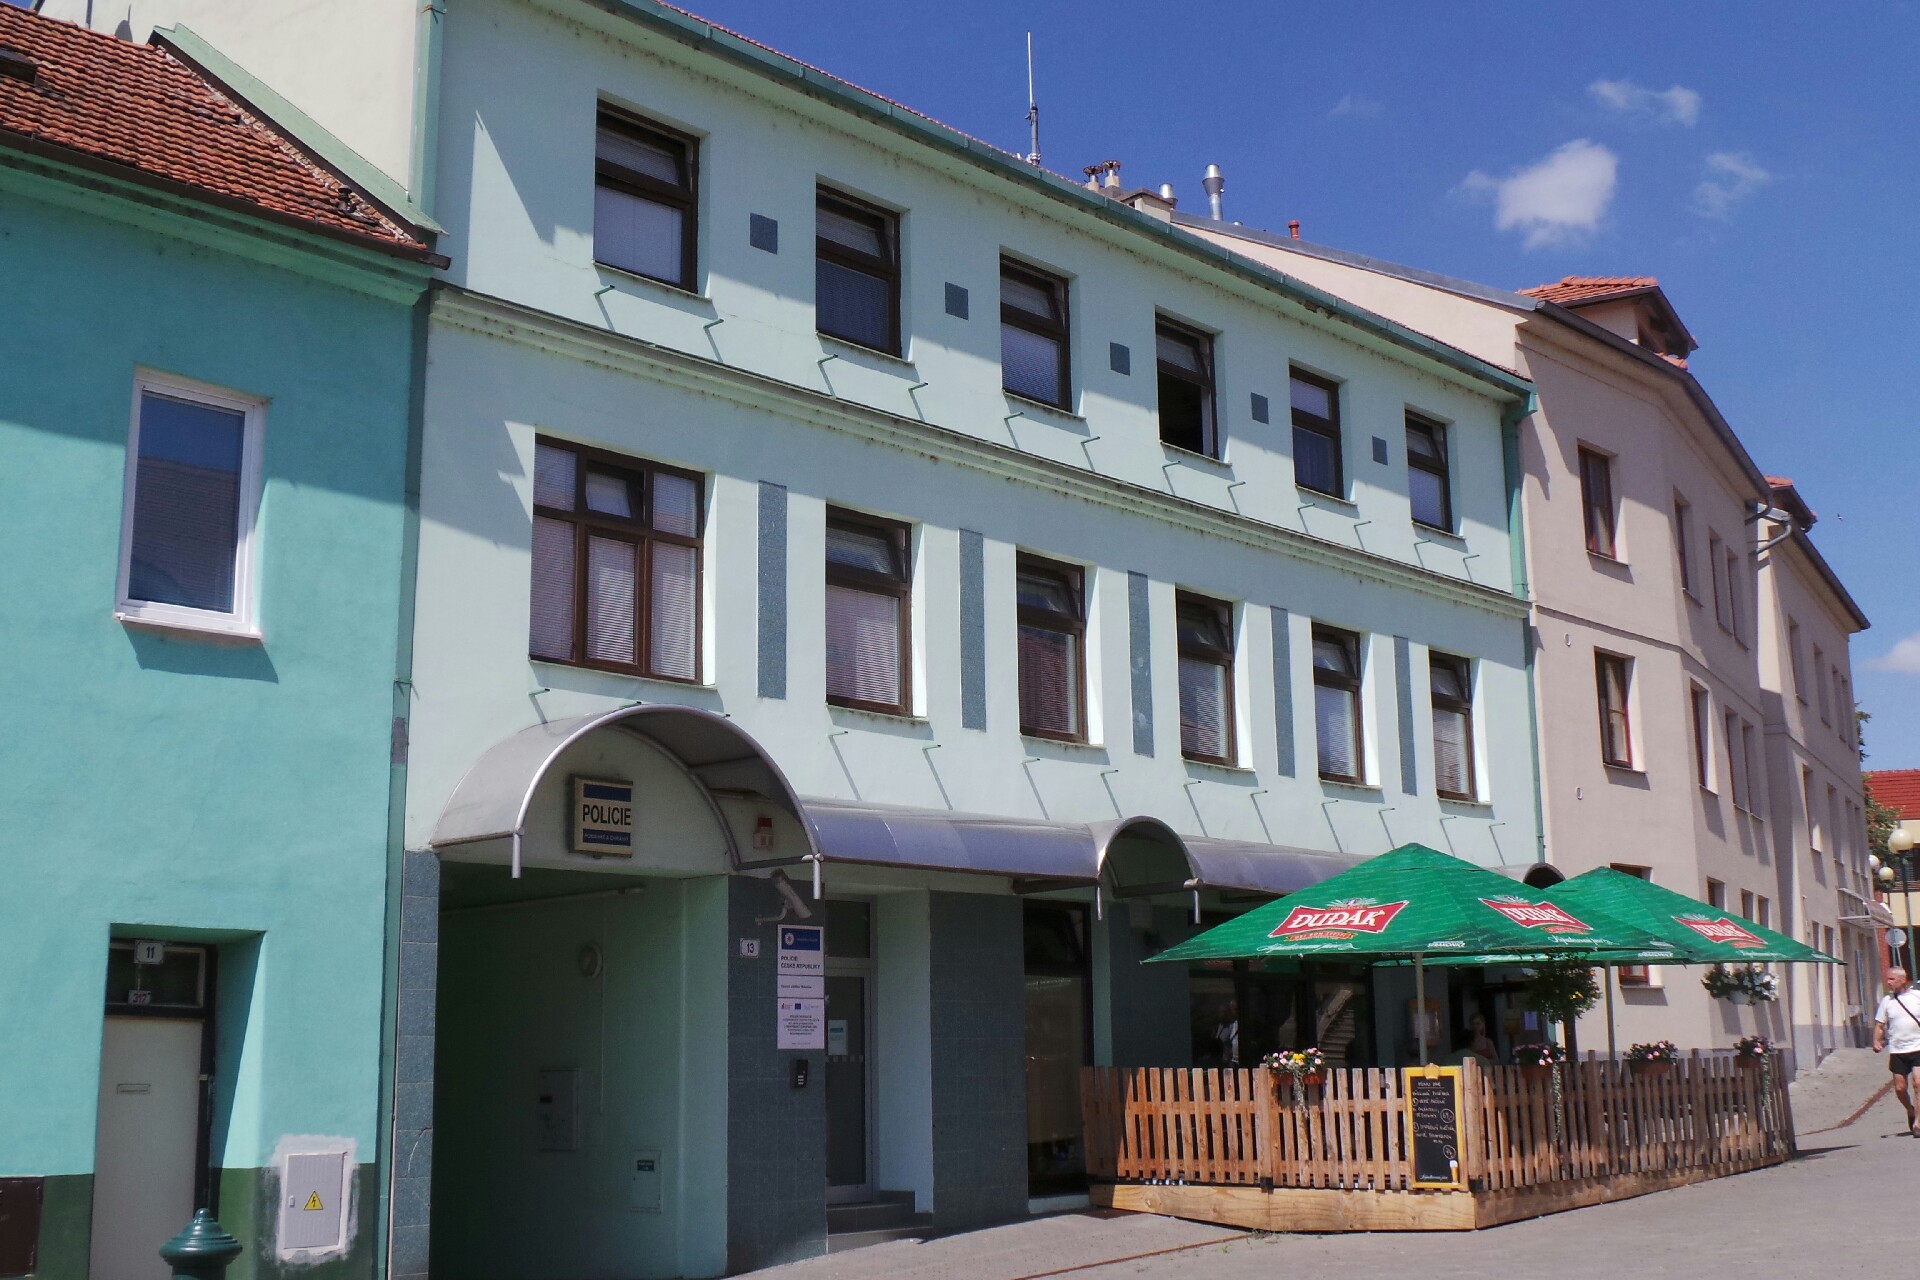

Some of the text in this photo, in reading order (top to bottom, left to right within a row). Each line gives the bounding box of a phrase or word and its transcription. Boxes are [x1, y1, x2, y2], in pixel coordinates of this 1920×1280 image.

[582, 804, 631, 825] POLICIE
[146, 946, 154, 959] 11
[746, 942, 755, 954] 13
